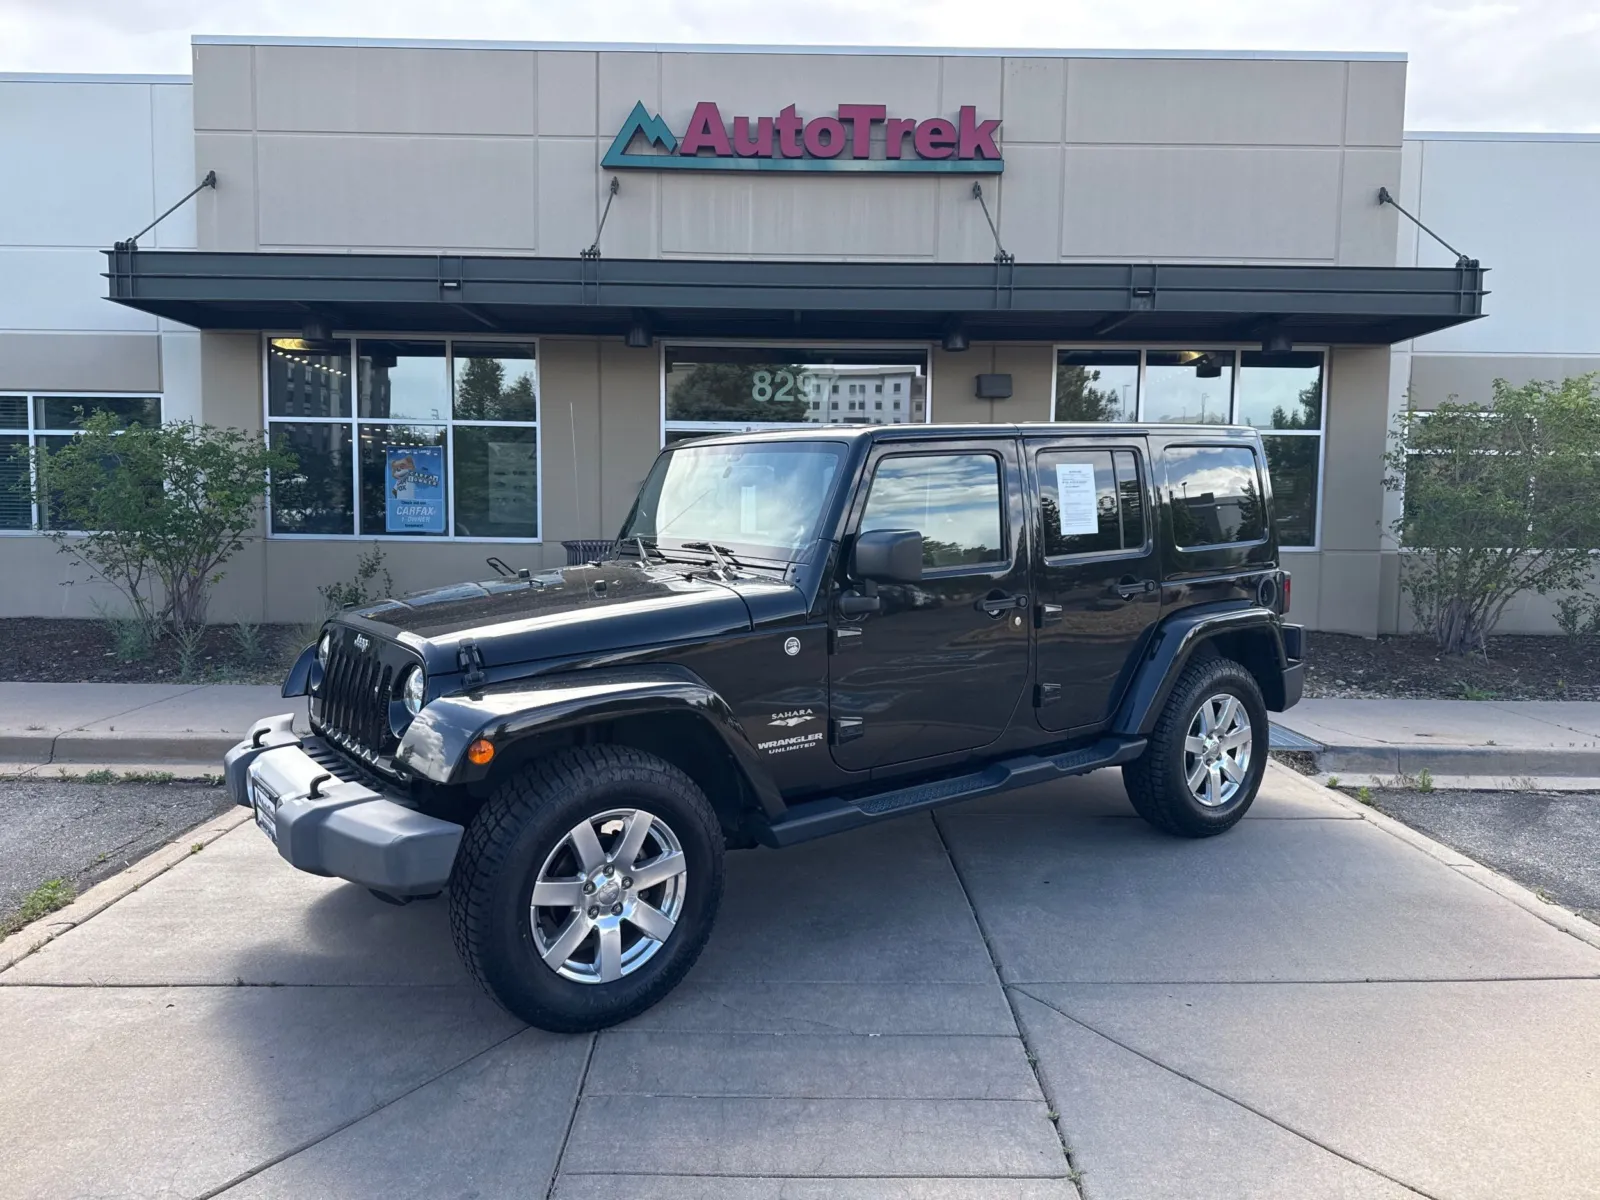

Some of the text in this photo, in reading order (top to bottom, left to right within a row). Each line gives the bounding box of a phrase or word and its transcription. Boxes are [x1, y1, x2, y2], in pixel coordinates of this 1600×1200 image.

[679, 101, 1003, 160] AutoTrek
[396, 506, 435, 516] CARFAX
[771, 708, 813, 720] SAHARA
[757, 732, 823, 750] WRANGLER
[768, 742, 816, 754] UNLIMITED
